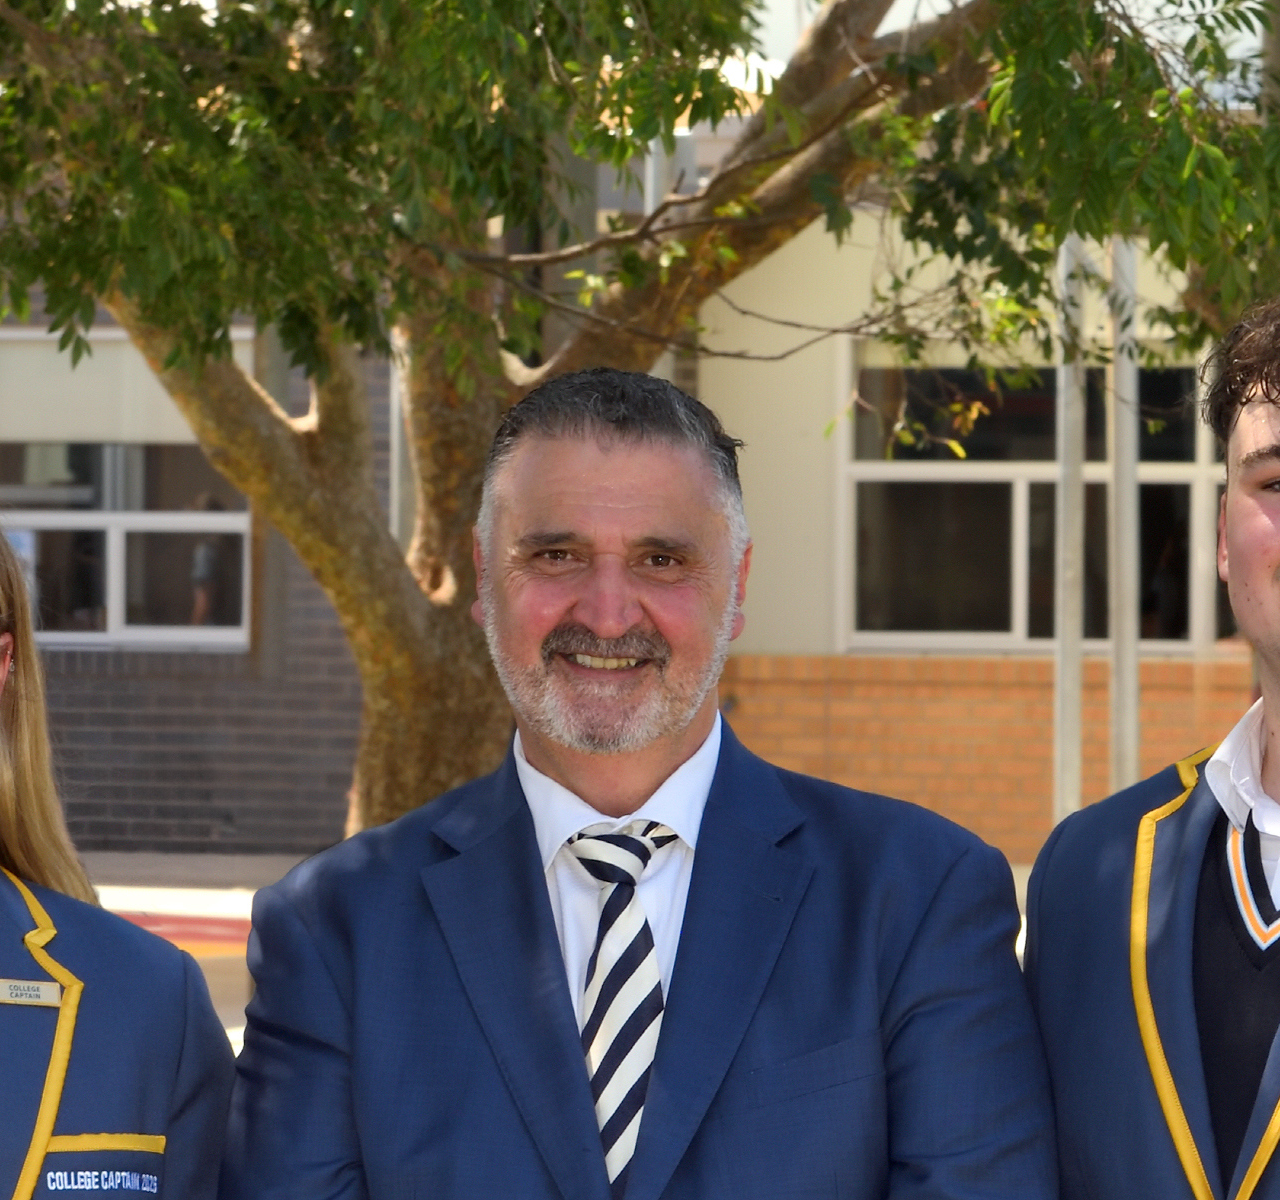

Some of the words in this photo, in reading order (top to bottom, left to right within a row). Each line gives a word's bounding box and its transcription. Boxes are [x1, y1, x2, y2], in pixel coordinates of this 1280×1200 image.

[9, 984, 40, 992] COLLEGE
[10, 991, 41, 999] CAPTAIN
[47, 1170, 99, 1191] COLLEGE
[101, 1170, 140, 1191] CAPTAIN
